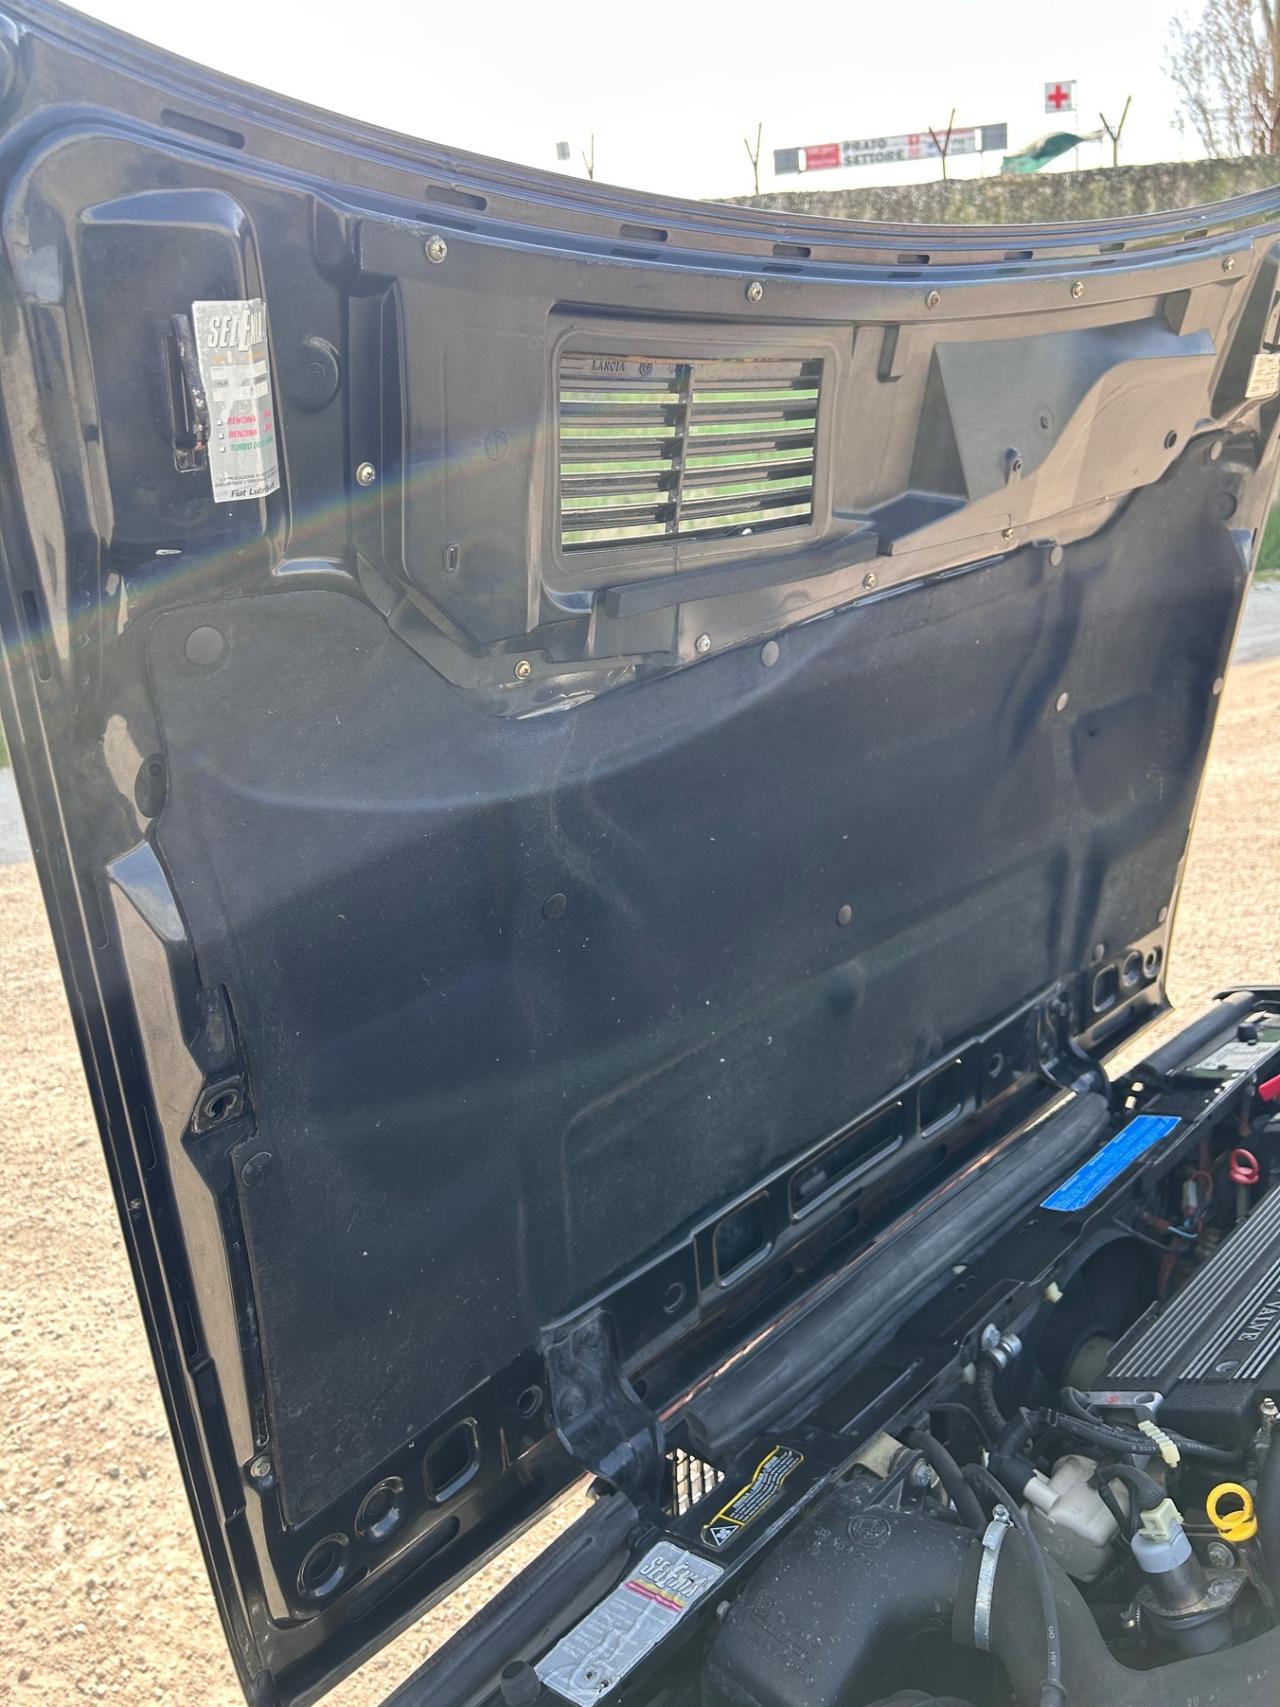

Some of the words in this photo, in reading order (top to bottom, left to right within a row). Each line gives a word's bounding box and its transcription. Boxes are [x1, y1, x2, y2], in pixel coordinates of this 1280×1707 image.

[843, 138, 888, 154] PRATO
[845, 149, 905, 167] SETTORE
[591, 359, 625, 373] LANCIA
[231, 488, 247, 498] Fiat
